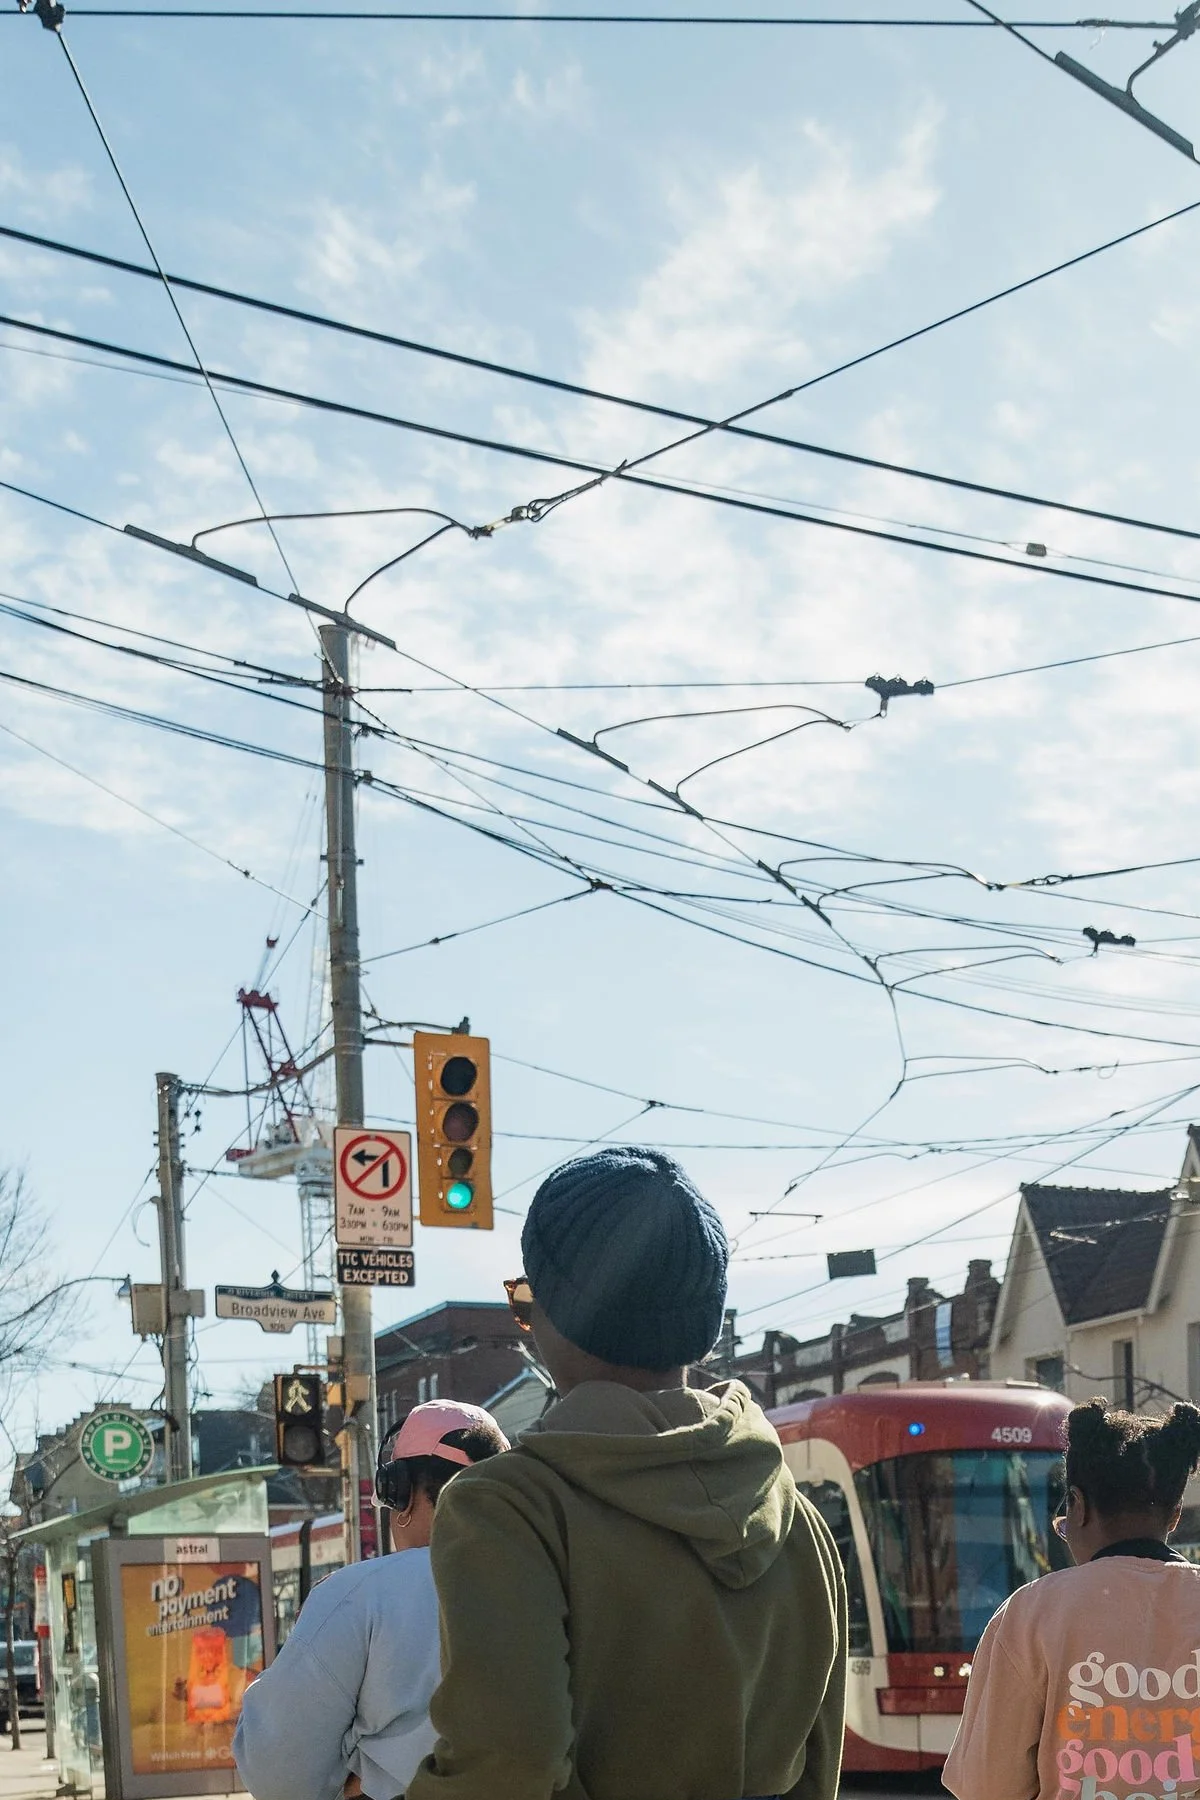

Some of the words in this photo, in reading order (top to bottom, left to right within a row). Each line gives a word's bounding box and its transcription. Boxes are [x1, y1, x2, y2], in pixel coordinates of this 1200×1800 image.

[339, 1252, 358, 1266] TTC
[361, 1253, 413, 1268] VEHICLES
[343, 1269, 409, 1284] EXCEPTED
[231, 1302, 297, 1319] Broadview
[303, 1306, 326, 1320] Ave
[991, 1427, 1032, 1443] 4509
[176, 1543, 208, 1555] astral
[151, 1575, 181, 1602] no
[159, 1577, 237, 1622] payment
[146, 1605, 229, 1637] entertainment
